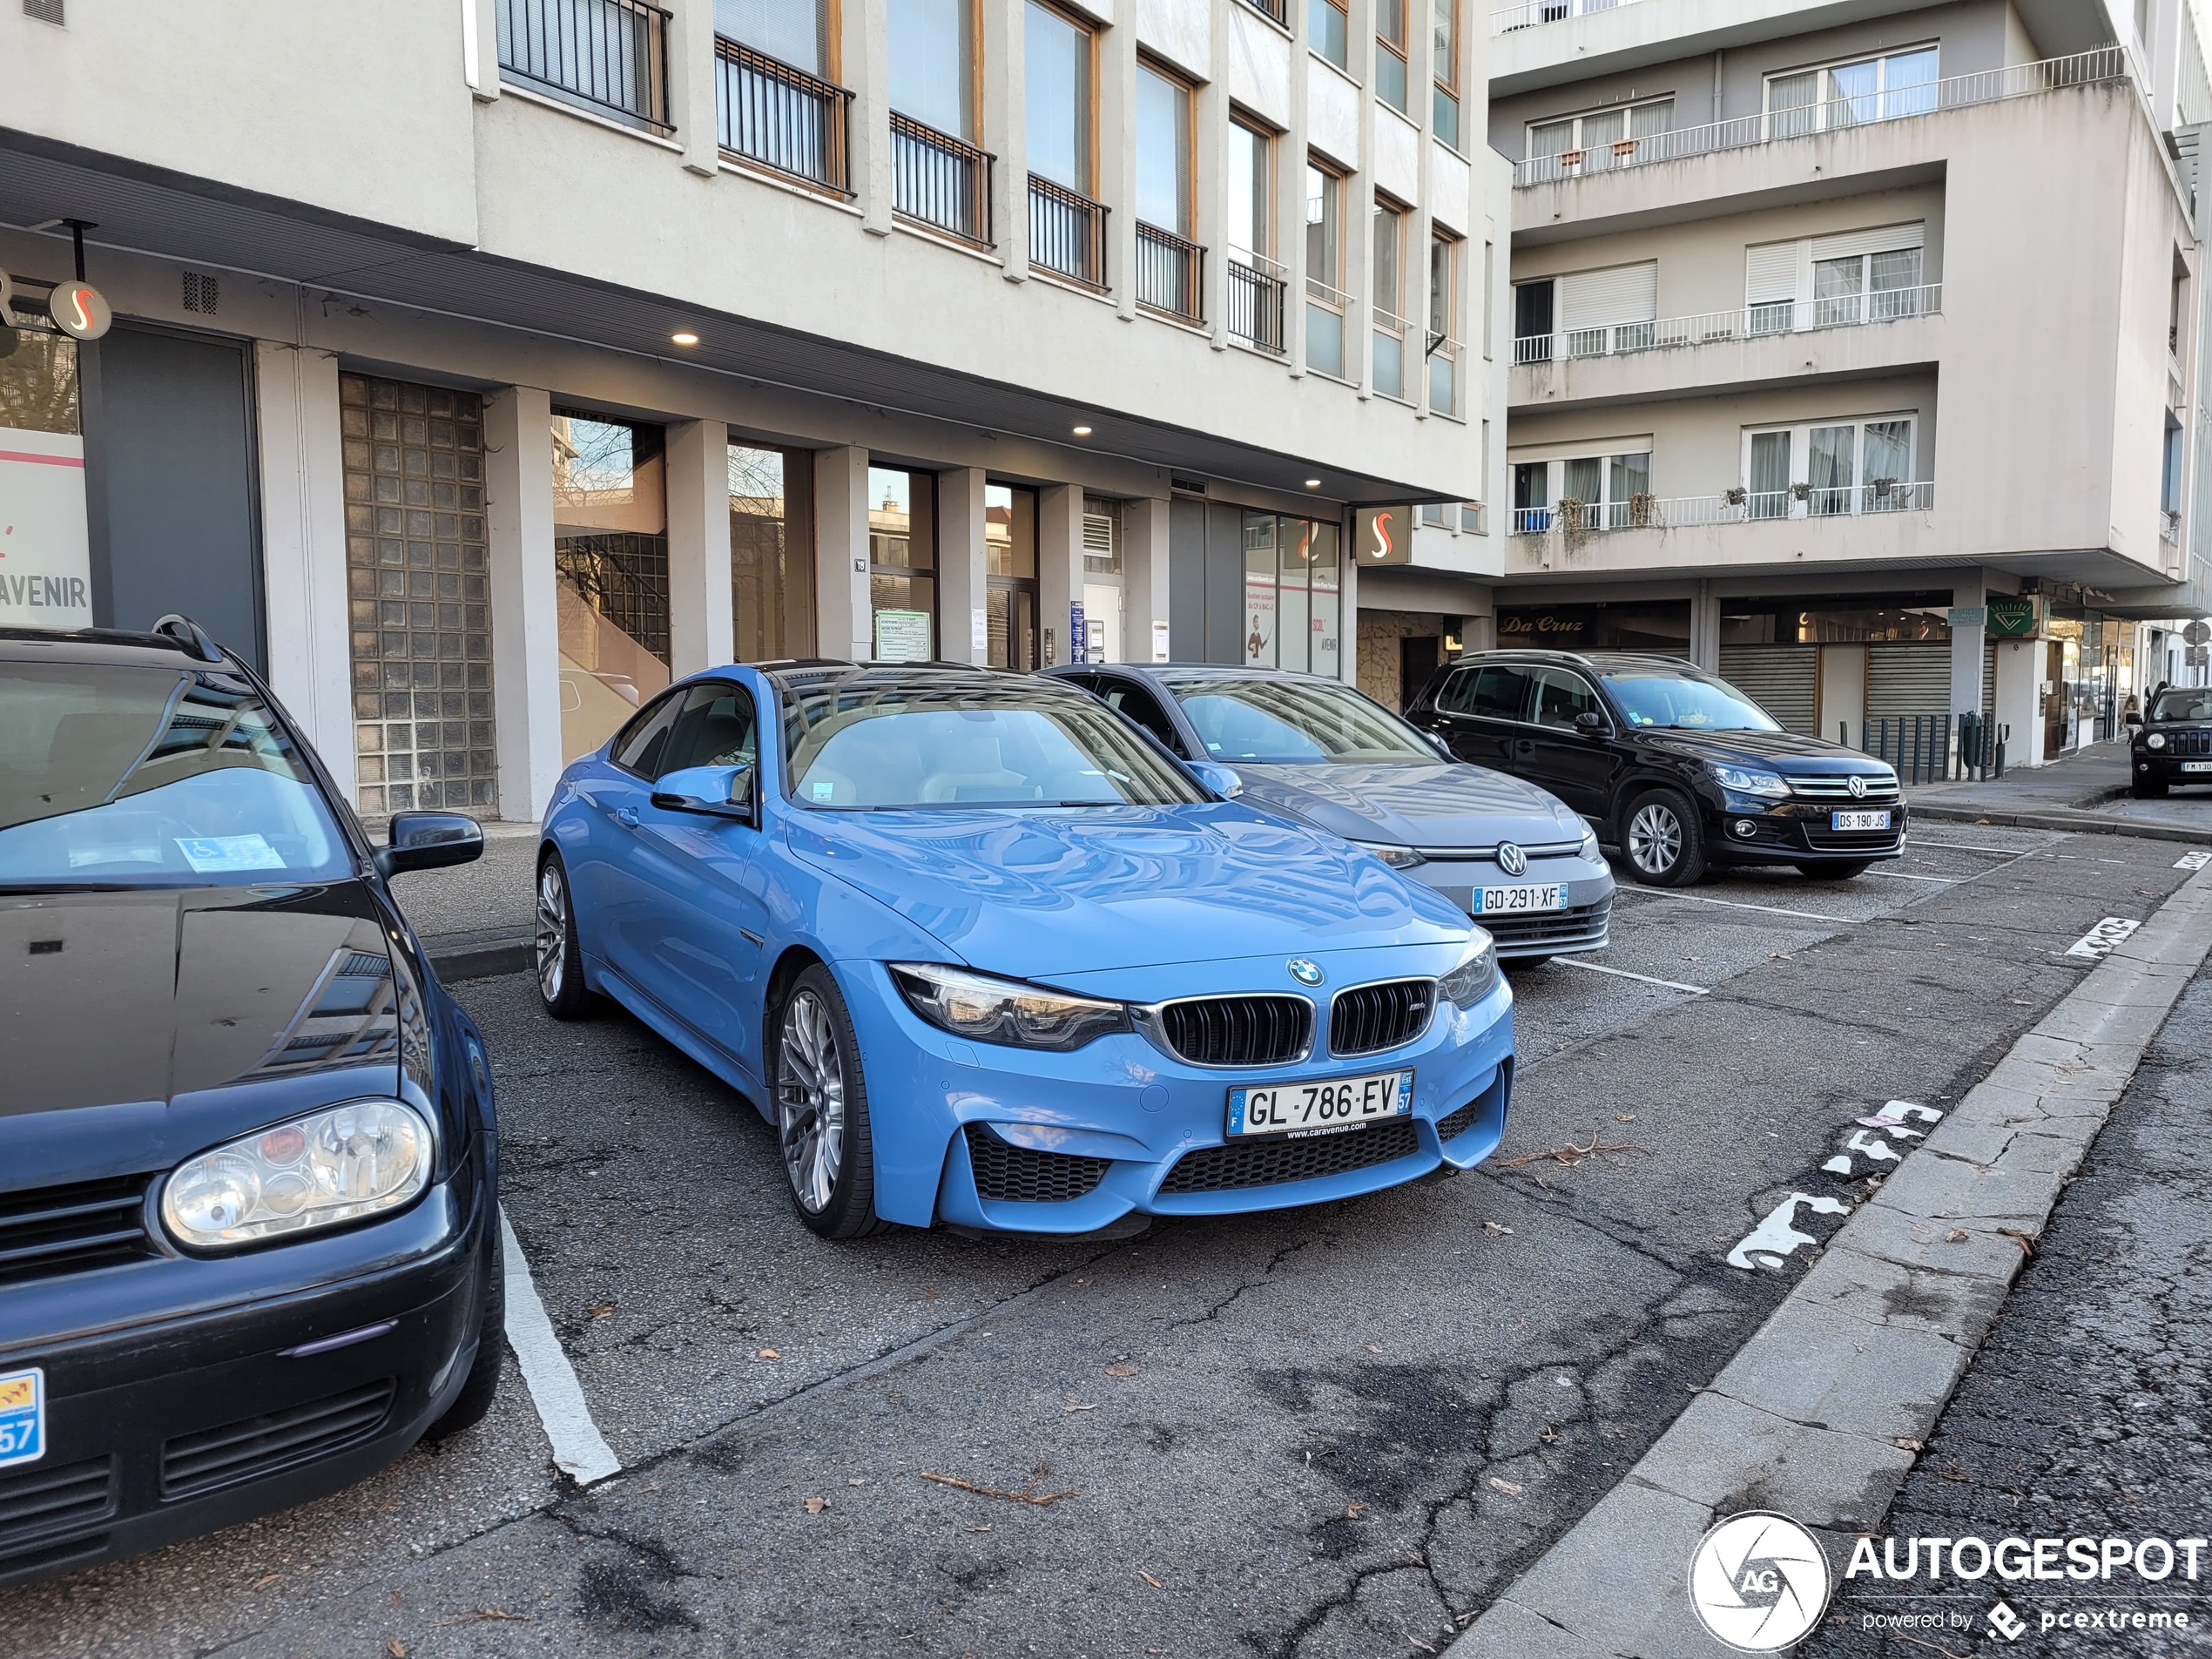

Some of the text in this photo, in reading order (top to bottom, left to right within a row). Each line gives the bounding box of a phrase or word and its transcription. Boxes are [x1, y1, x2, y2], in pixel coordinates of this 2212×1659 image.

[856, 560, 865, 570] 18
[1500, 616, 1584, 633] Da Cruz
[1321, 637, 1337, 651] AVENIR
[1839, 814, 1885, 827] DS-190-JS
[1485, 887, 1558, 910] GD-291-XF
[1559, 896, 1567, 907] 57
[1231, 1077, 1395, 1127] F GL-786-EV
[1398, 1092, 1411, 1109] 57
[1287, 1122, 1366, 1139] www.caravenue.com
[0, 1419, 35, 1453] 57
